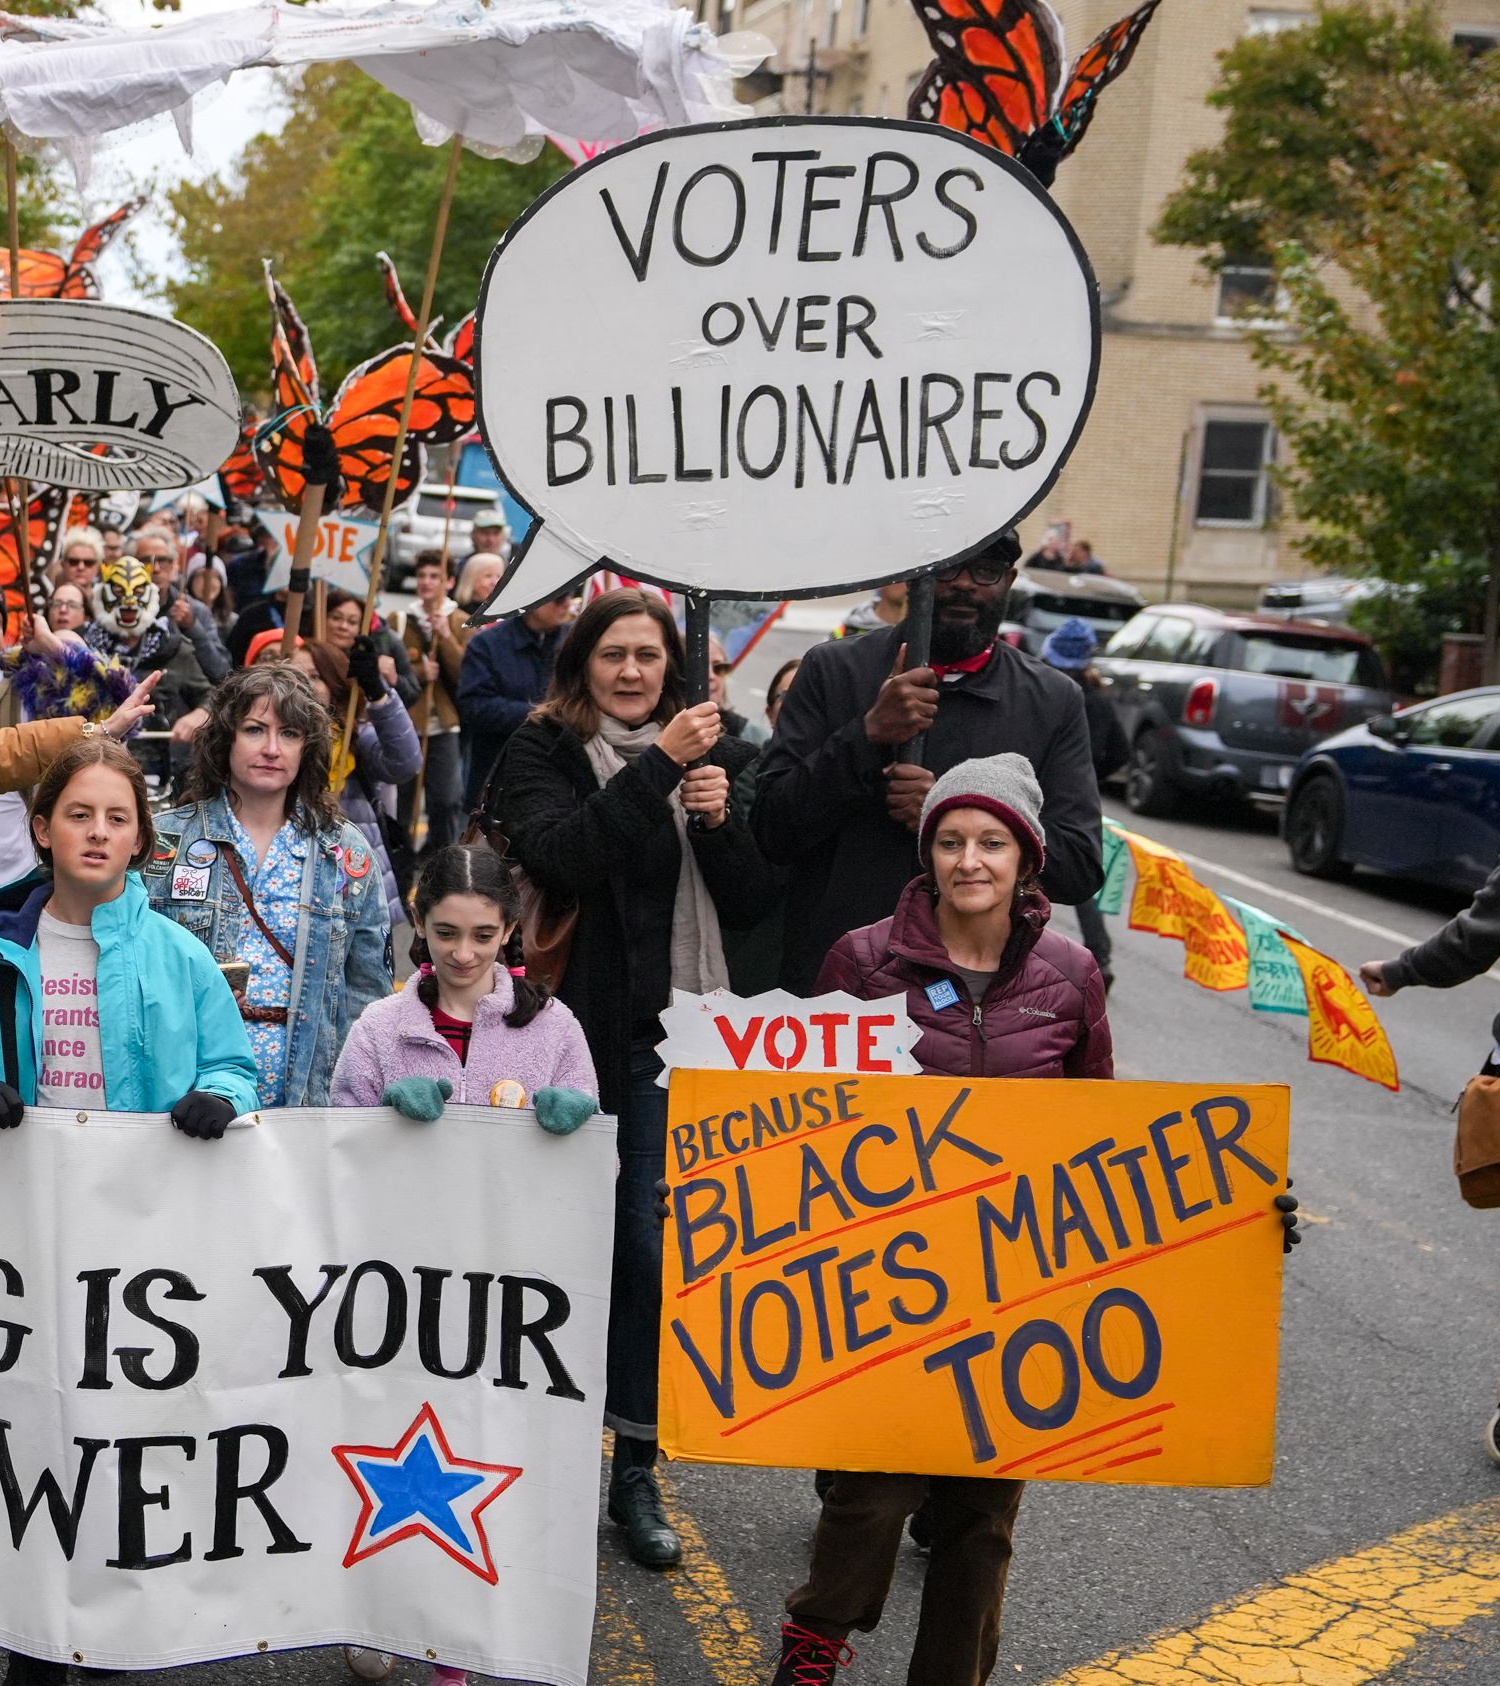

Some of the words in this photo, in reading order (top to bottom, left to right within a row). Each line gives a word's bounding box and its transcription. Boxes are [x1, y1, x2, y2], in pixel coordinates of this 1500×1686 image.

[599, 150, 985, 283] VOTERS
[701, 295, 883, 359] OVER
[546, 371, 1062, 488] BILLIONAIRES
[41, 973, 98, 996] esist
[42, 1006, 100, 1028] rants
[930, 984, 948, 997] REP
[1026, 1007, 1057, 1019] Columbia
[41, 1063, 105, 1090] harao
[714, 1013, 895, 1072] VOTE
[670, 1079, 865, 1173] BECAUSE
[674, 1088, 1004, 1285] BLACK
[670, 1231, 948, 1419] VOTES
[976, 1096, 1278, 1303] MATTER
[76, 1268, 206, 1390] IS
[252, 1260, 586, 1402] YOUR
[923, 1287, 1163, 1463] TOO
